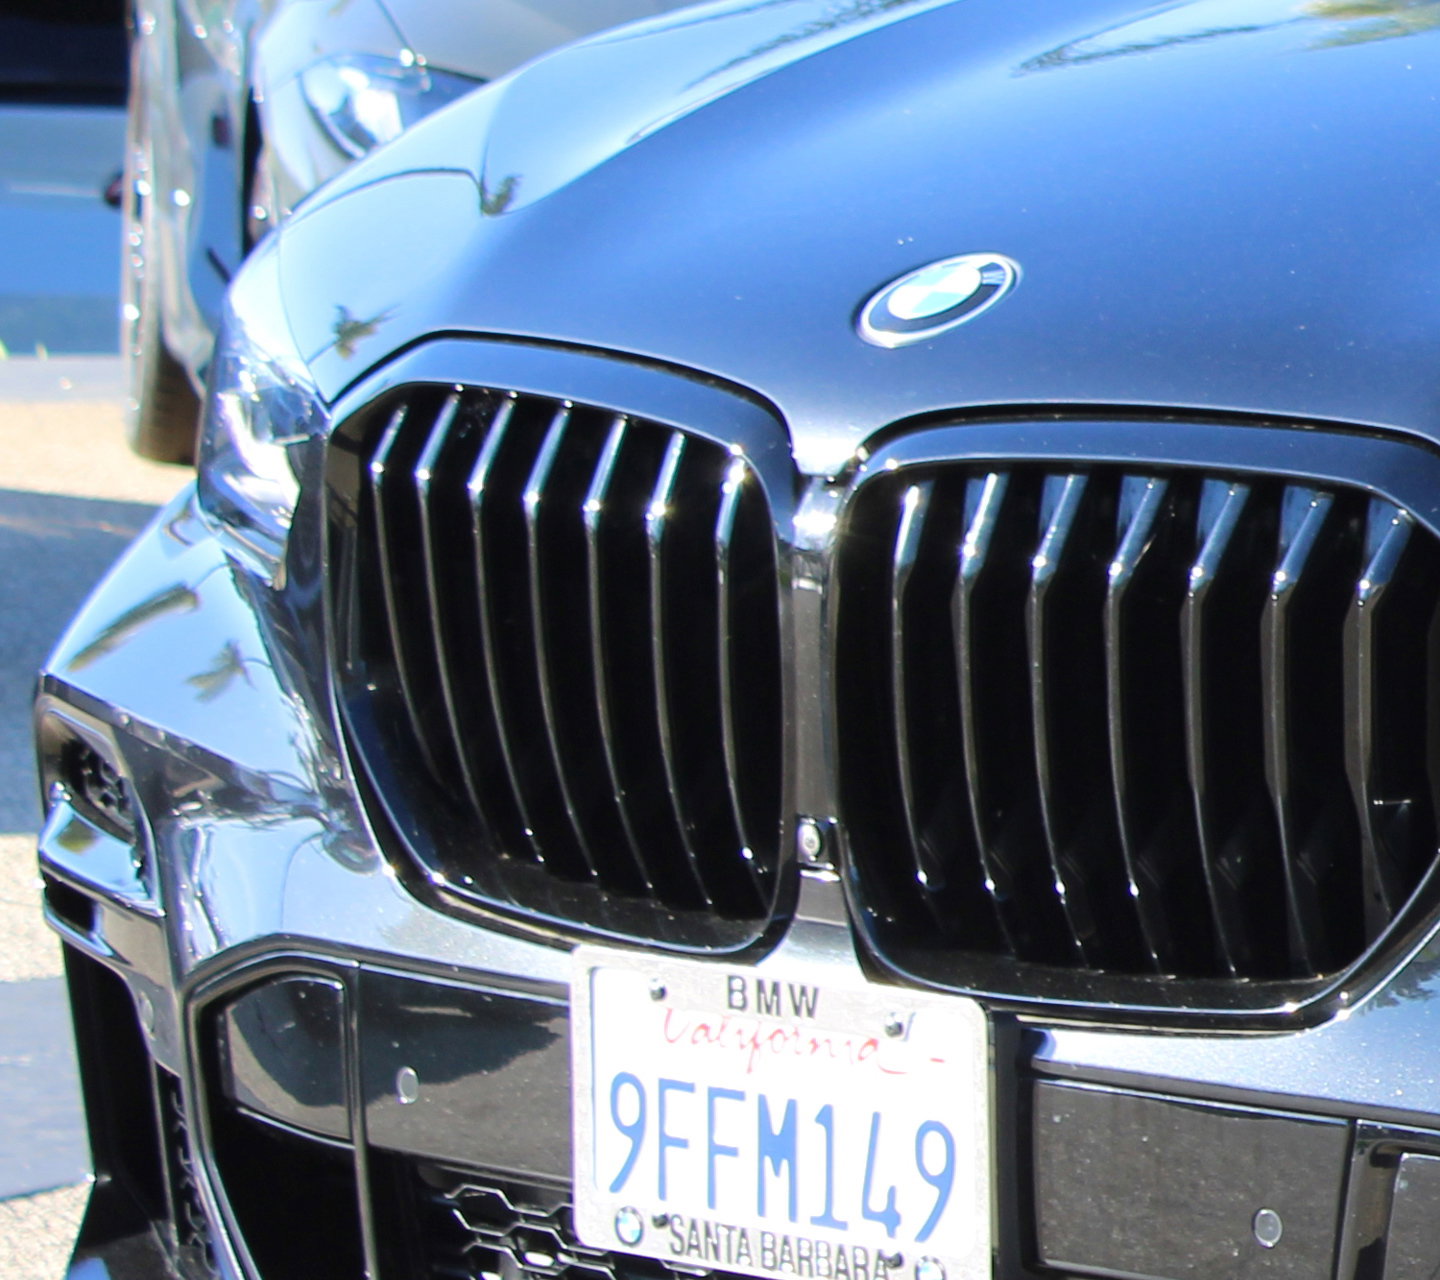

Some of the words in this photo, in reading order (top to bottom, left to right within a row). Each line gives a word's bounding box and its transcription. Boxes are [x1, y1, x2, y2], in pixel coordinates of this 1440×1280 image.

[726, 974, 820, 1018] BMW
[609, 1071, 956, 1243] 9FFM149
[668, 1214, 752, 1269] SANTA
